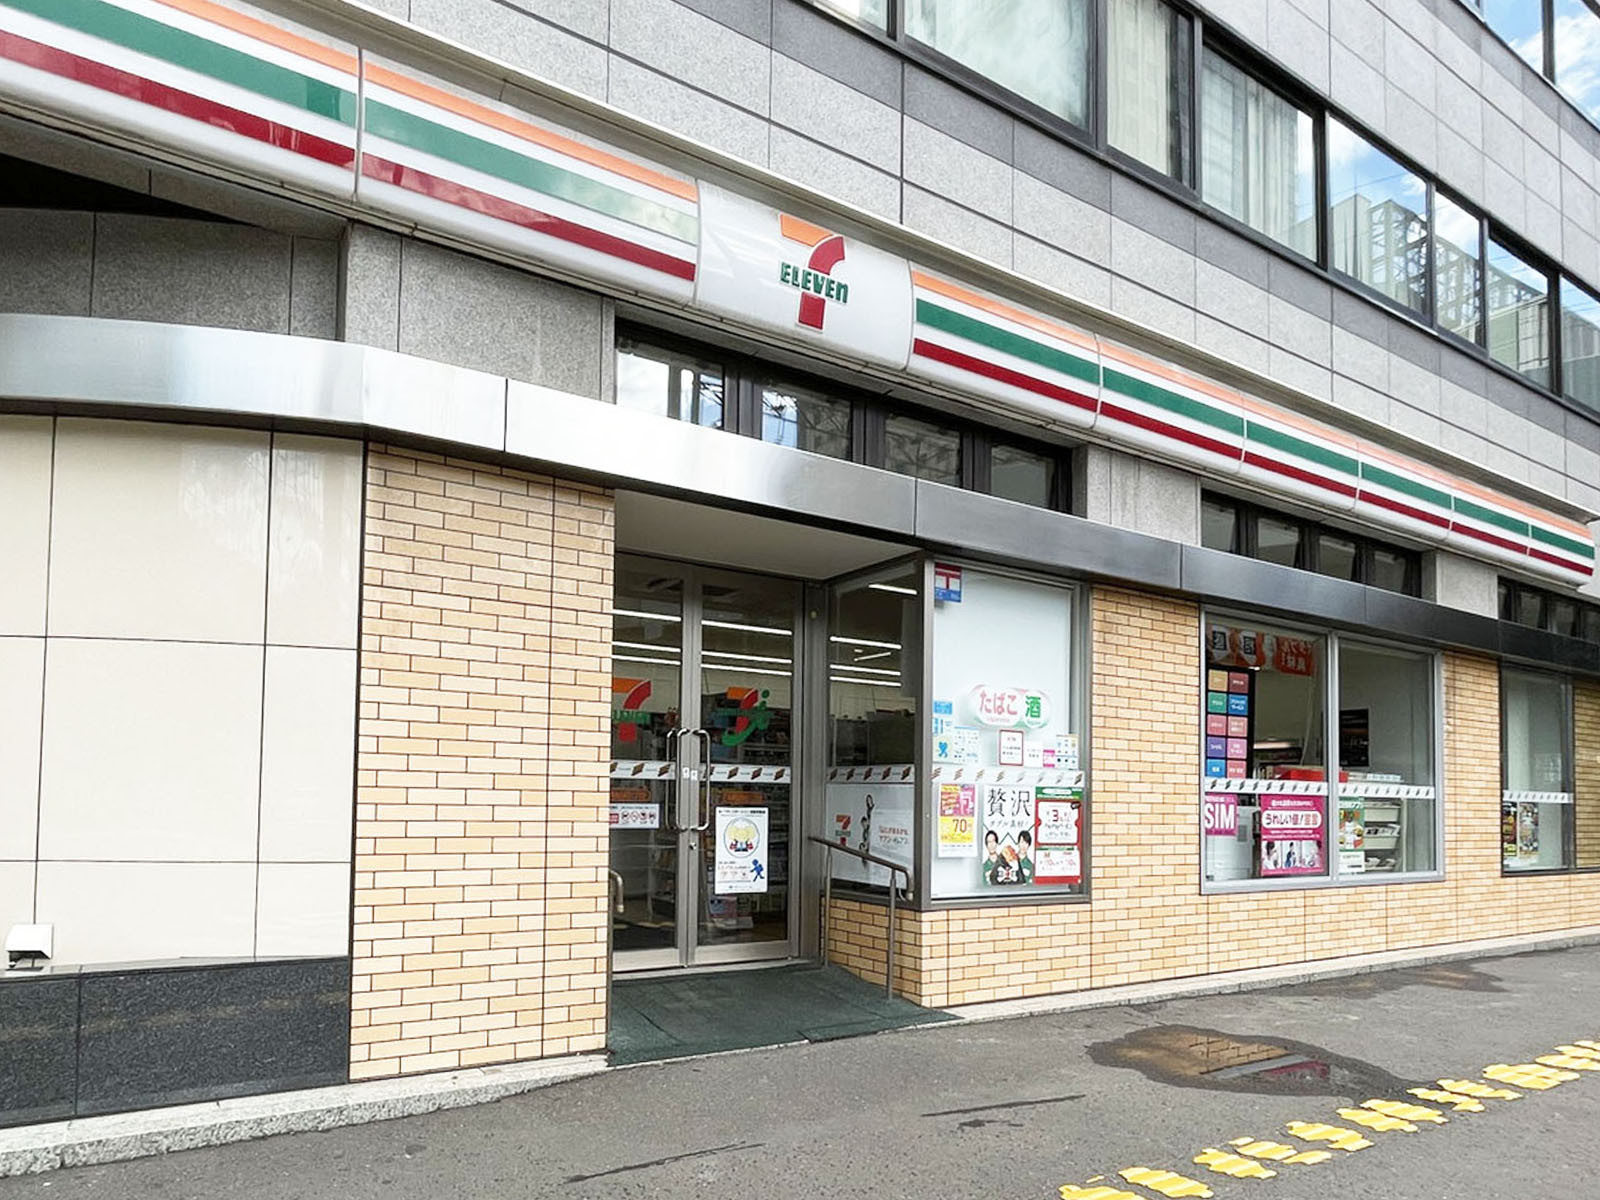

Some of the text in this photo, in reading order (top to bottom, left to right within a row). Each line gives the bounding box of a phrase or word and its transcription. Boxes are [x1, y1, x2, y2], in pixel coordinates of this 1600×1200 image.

[979, 690, 1018, 715] たばこ
[1025, 695, 1042, 718] 酒
[987, 787, 1031, 817] 贅沢
[1204, 802, 1235, 830] SIM
